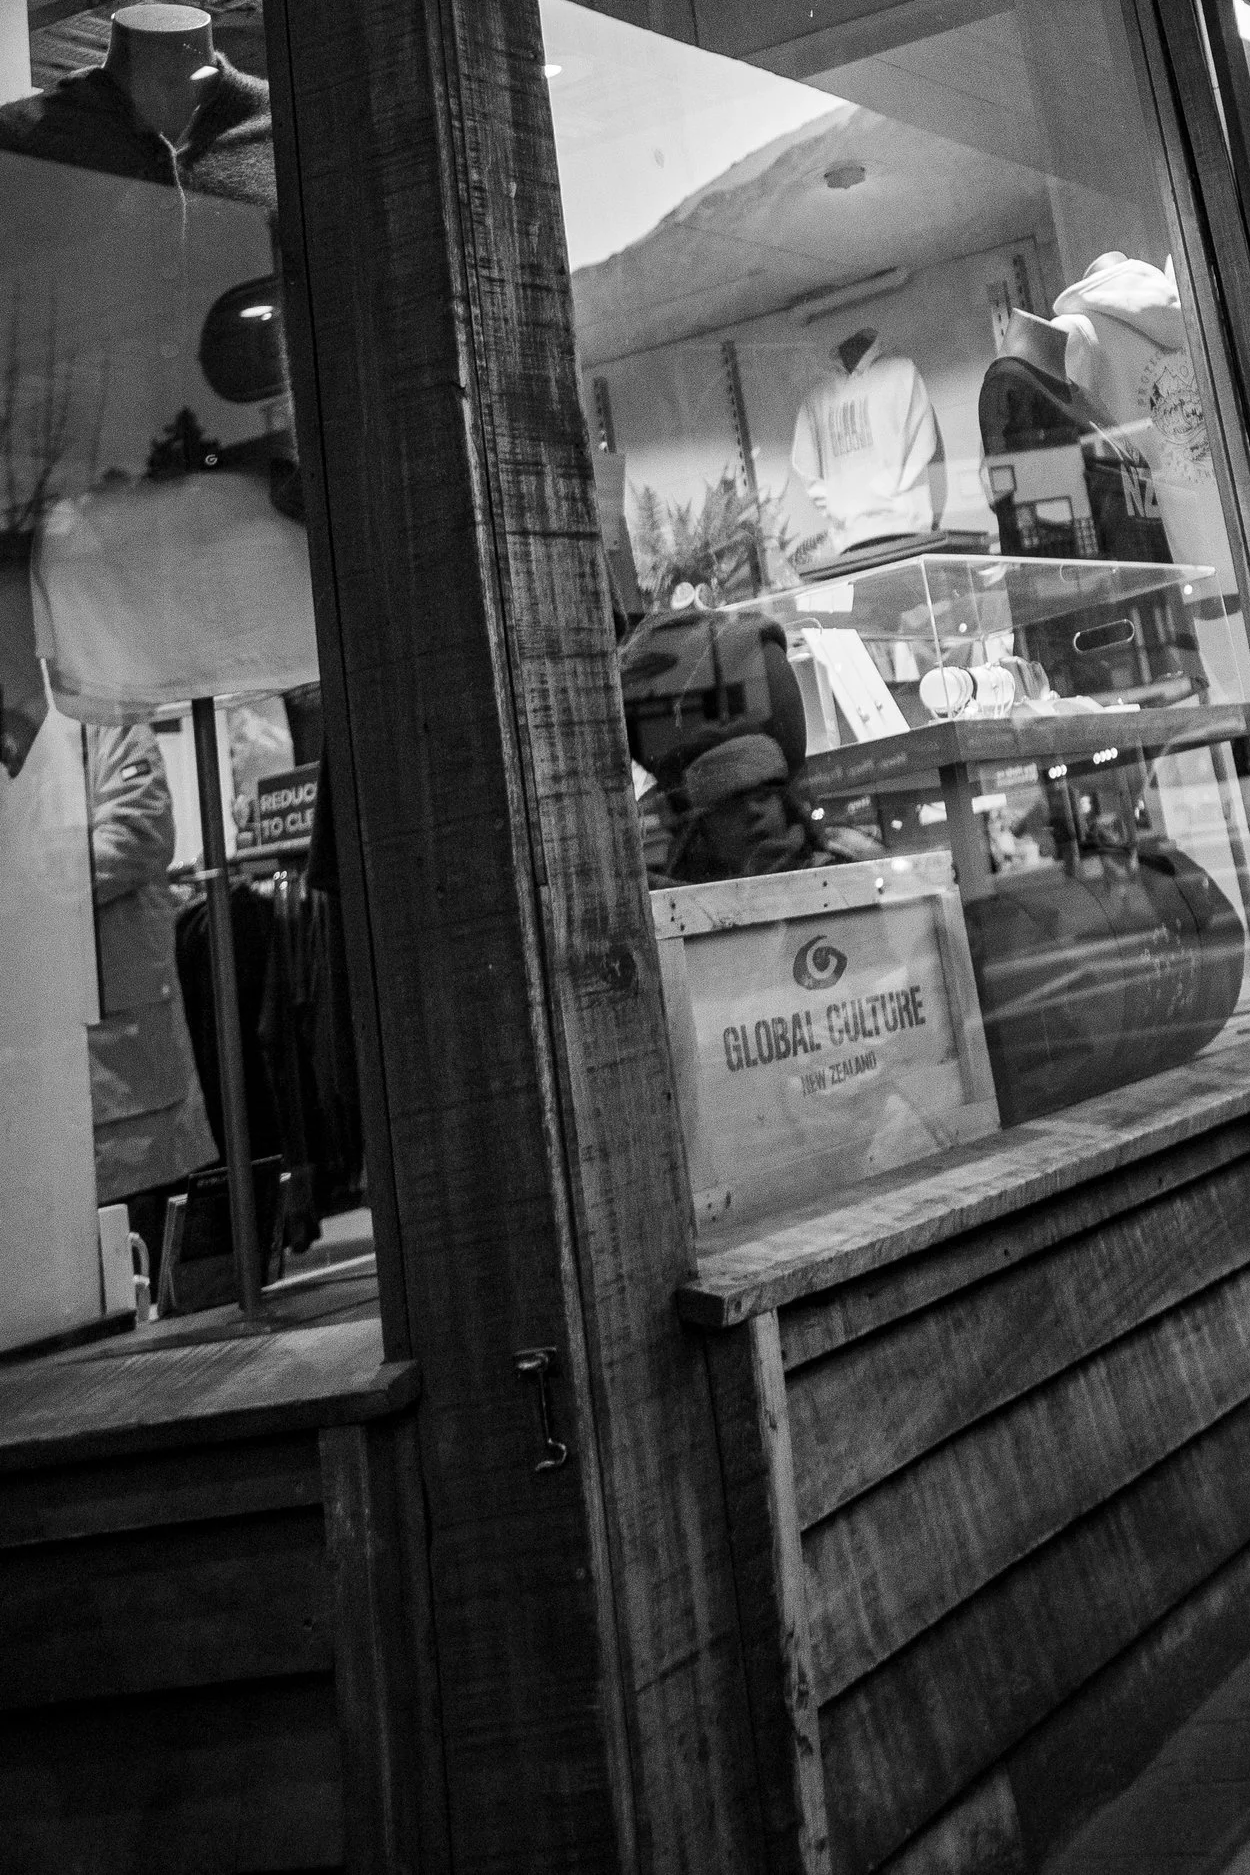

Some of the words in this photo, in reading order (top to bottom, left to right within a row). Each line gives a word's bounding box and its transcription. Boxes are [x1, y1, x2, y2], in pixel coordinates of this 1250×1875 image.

[262, 816, 284, 838] TO
[723, 1011, 822, 1073] GLOBAL
[825, 985, 926, 1047] CULTURE
[801, 1071, 827, 1097] NEW
[829, 1050, 878, 1086] ZEALAND
